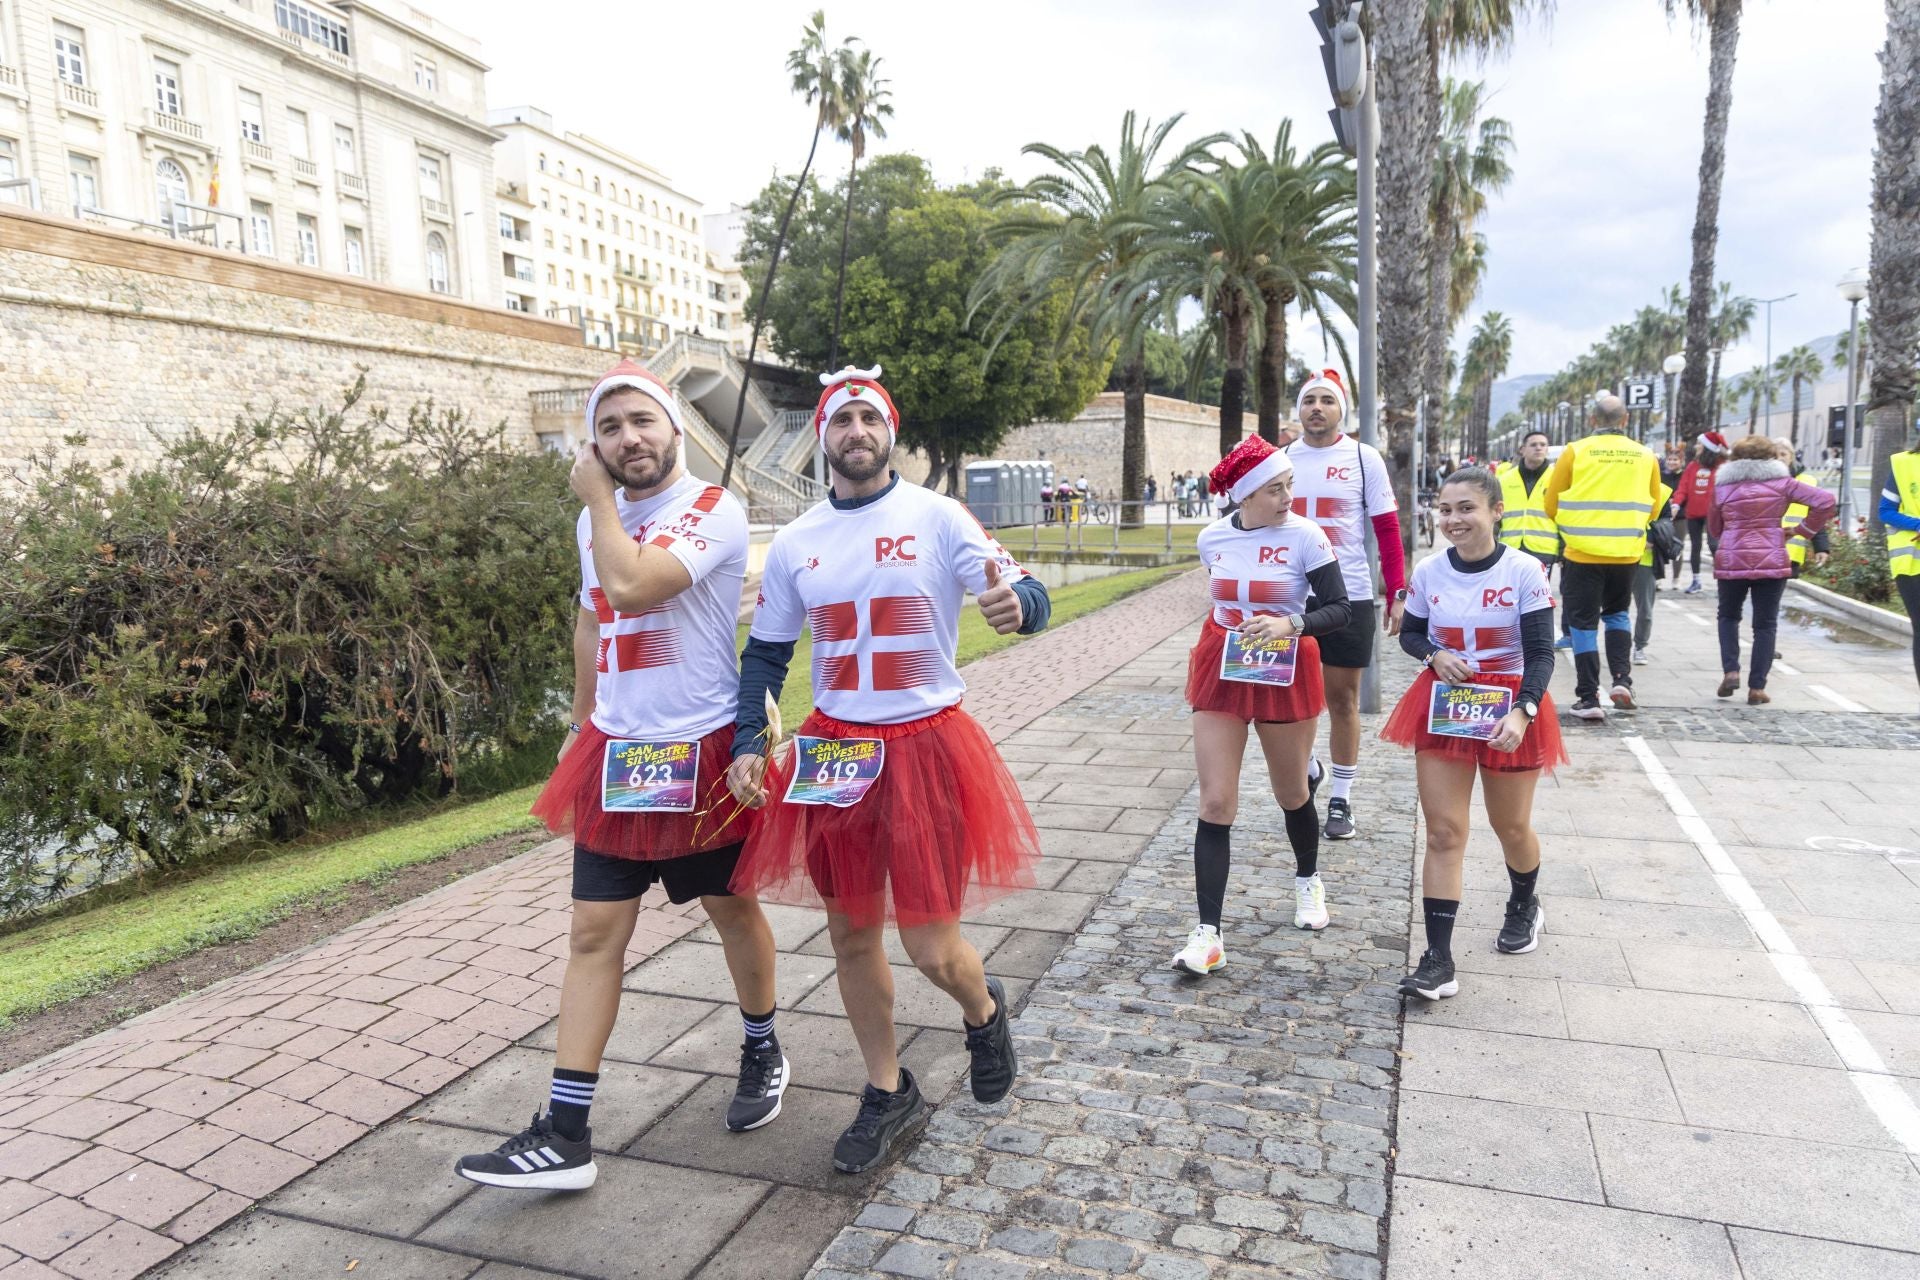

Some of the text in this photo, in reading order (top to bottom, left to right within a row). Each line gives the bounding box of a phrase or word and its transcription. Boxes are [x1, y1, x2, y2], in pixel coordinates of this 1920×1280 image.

[1630, 385, 1649, 404] P
[1242, 650, 1278, 667] 617
[1449, 692, 1504, 704] SILVESTRE
[1450, 688, 1472, 697] SAN
[1446, 702, 1496, 723] 1984
[626, 744, 690, 768] SILVESTRE
[627, 744, 653, 757] SAN
[816, 742, 876, 763] SILVESTRE
[817, 741, 841, 753] SAN
[652, 754, 690, 766] CARTAGENA
[629, 764, 673, 787] 623
[816, 761, 859, 784] 619
